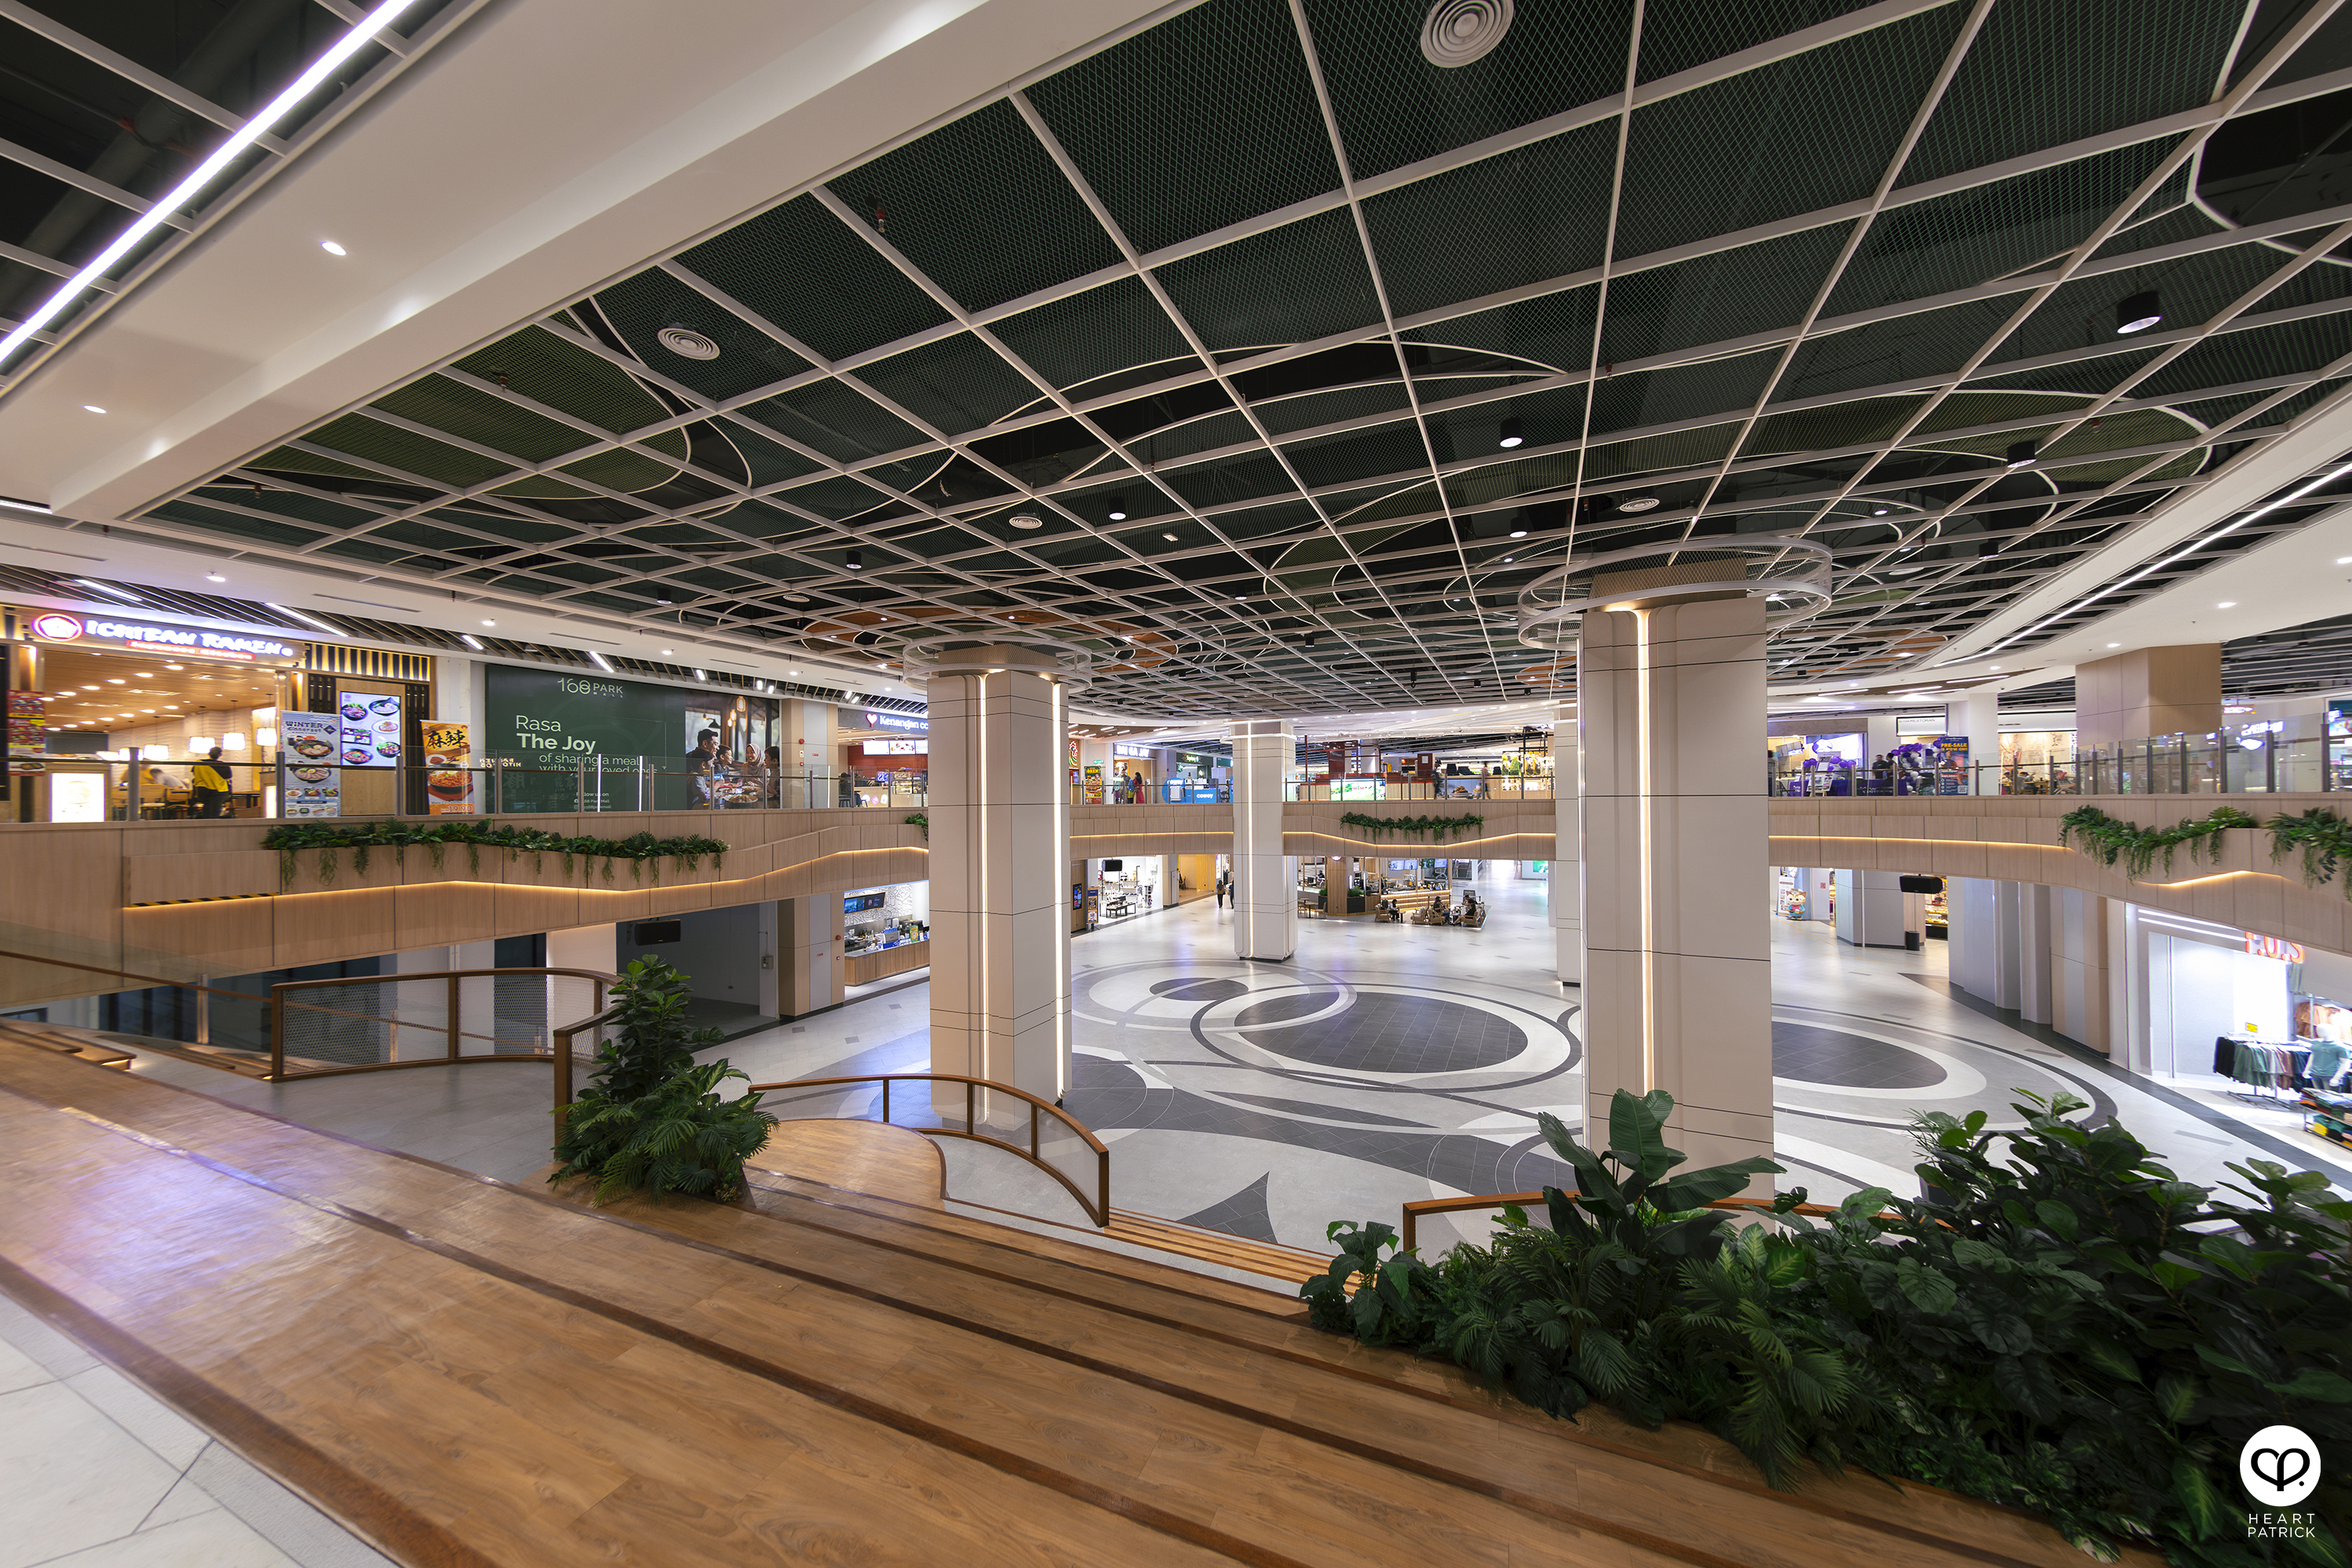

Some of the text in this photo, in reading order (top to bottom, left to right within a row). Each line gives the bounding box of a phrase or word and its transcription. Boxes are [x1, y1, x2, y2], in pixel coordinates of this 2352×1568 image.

[557, 677, 623, 695] 168 PARK
[516, 714, 561, 732] Rasa
[879, 714, 920, 730] Kenangan
[426, 729, 466, 749] 麻辣
[516, 732, 596, 755] The Joy
[539, 753, 553, 763] of
[555, 754, 598, 766] sharing
[613, 757, 640, 766] meal
